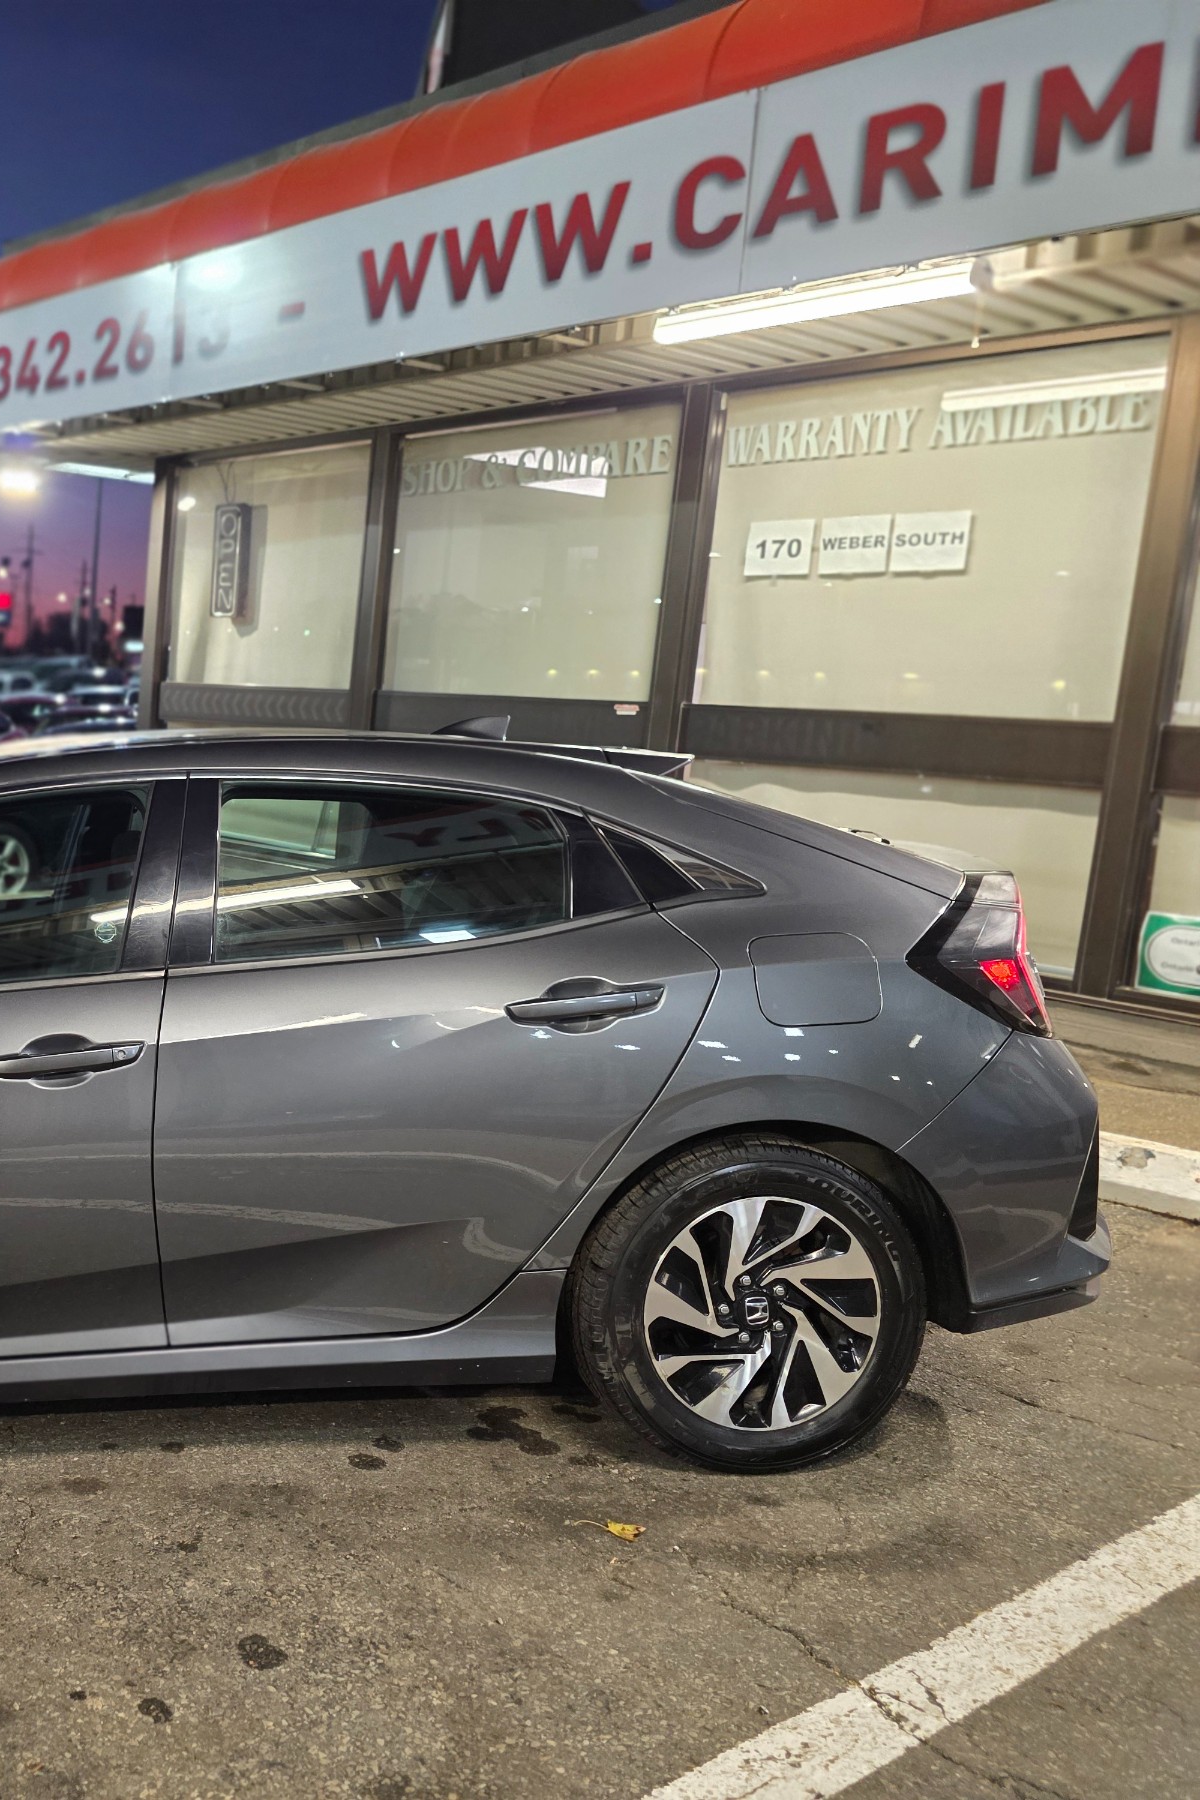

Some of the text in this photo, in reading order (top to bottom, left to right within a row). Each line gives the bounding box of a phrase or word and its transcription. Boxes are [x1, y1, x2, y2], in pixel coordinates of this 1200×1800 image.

[361, 36, 1200, 319] WWW.CARIM
[403, 457, 474, 496] SHOP
[516, 435, 672, 484] COMPARE
[726, 393, 1150, 466] WARRANTY AVAILABLE
[217, 513, 237, 609] OPEN
[755, 531, 965, 559] 170 WEBER SOUTH
